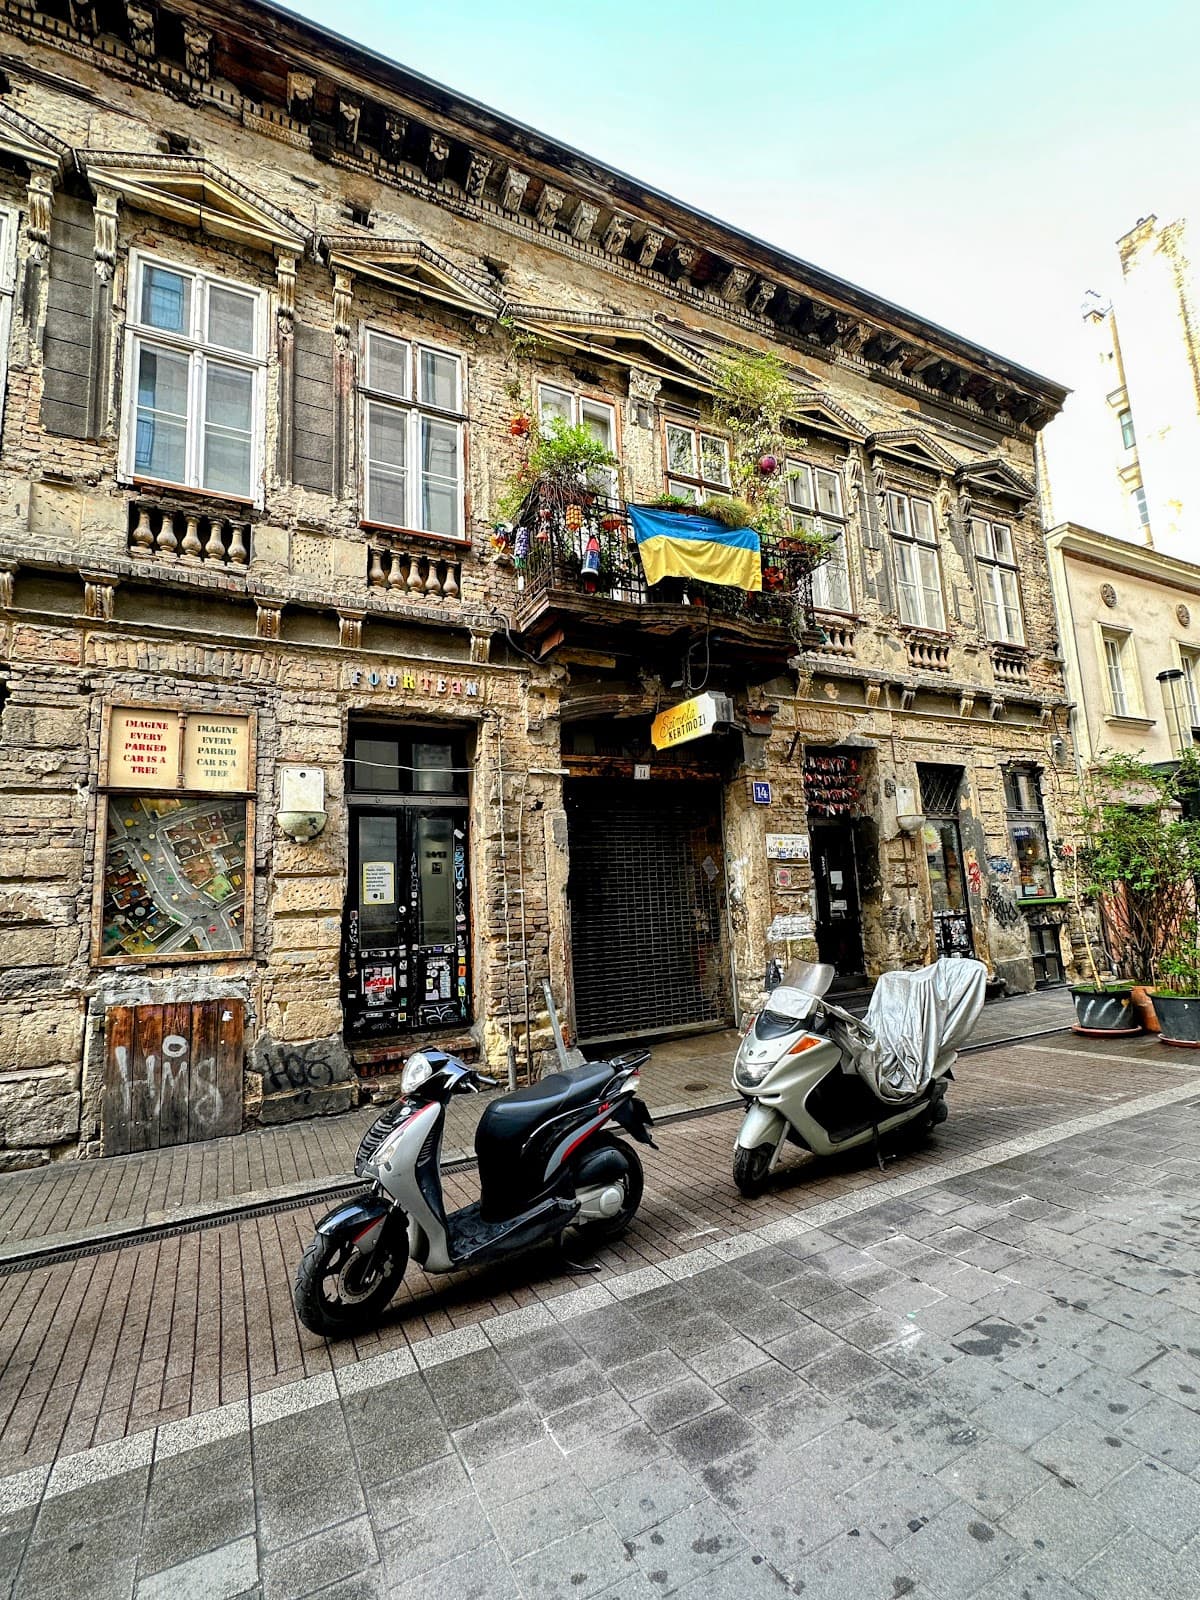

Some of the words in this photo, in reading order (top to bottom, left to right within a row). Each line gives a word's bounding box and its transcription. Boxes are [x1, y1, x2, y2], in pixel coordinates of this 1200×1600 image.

[352, 671, 478, 696] FOURTEEN
[125, 719, 169, 730] IMAGINE
[668, 713, 706, 742] KERTMOZI
[197, 725, 239, 734] IMAGINE
[130, 732, 163, 741] EVERY
[202, 737, 233, 745] EVERY
[125, 743, 167, 752] PARKED
[197, 747, 237, 755] PARKED
[123, 754, 144, 763] CAR
[146, 755, 157, 764] IS
[159, 756, 166, 764] A
[196, 758, 216, 766] CAR
[219, 759, 228, 767] IS
[131, 766, 158, 774] TREE
[756, 786, 768, 799] 14
